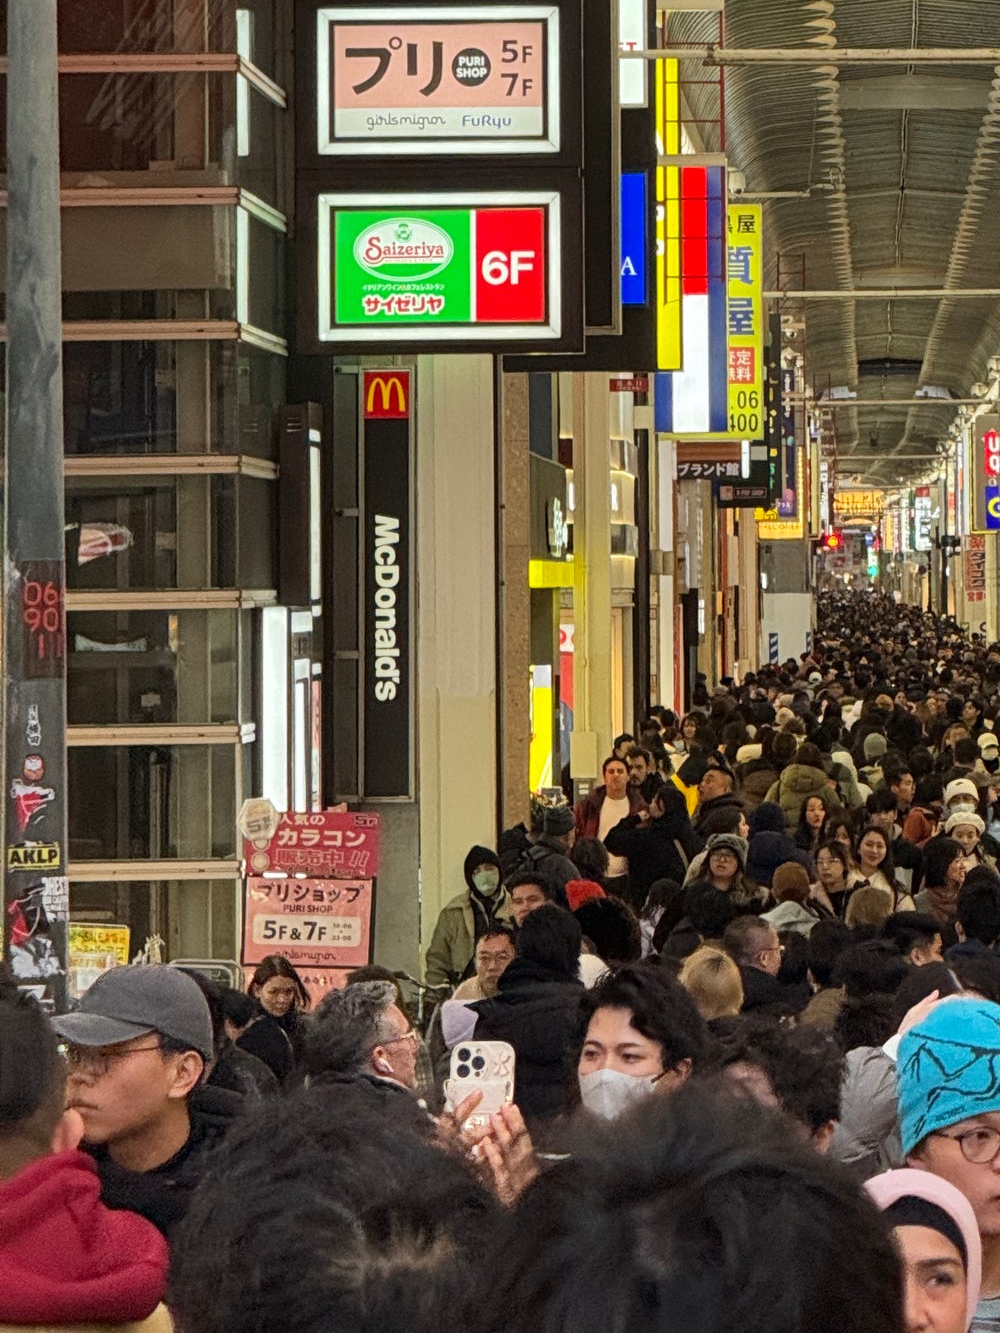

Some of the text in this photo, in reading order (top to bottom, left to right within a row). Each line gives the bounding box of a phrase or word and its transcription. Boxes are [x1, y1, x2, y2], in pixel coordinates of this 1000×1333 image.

[457, 56, 485, 66] PURI
[501, 40, 533, 64] 5F
[345, 36, 444, 97] プリ
[456, 67, 488, 78] SHOP
[500, 73, 533, 97] 7F
[462, 114, 512, 130] FuRyu
[364, 236, 444, 263] Saizeriya
[481, 250, 535, 285] 6F
[363, 294, 445, 314] サイゼリヤ
[677, 462, 740, 477] ブランド館
[374, 515, 400, 702] McDonald's
[277, 828, 367, 847] カラコン
[10, 848, 59, 864] AKLP
[283, 904, 334, 914] PURI SHOP
